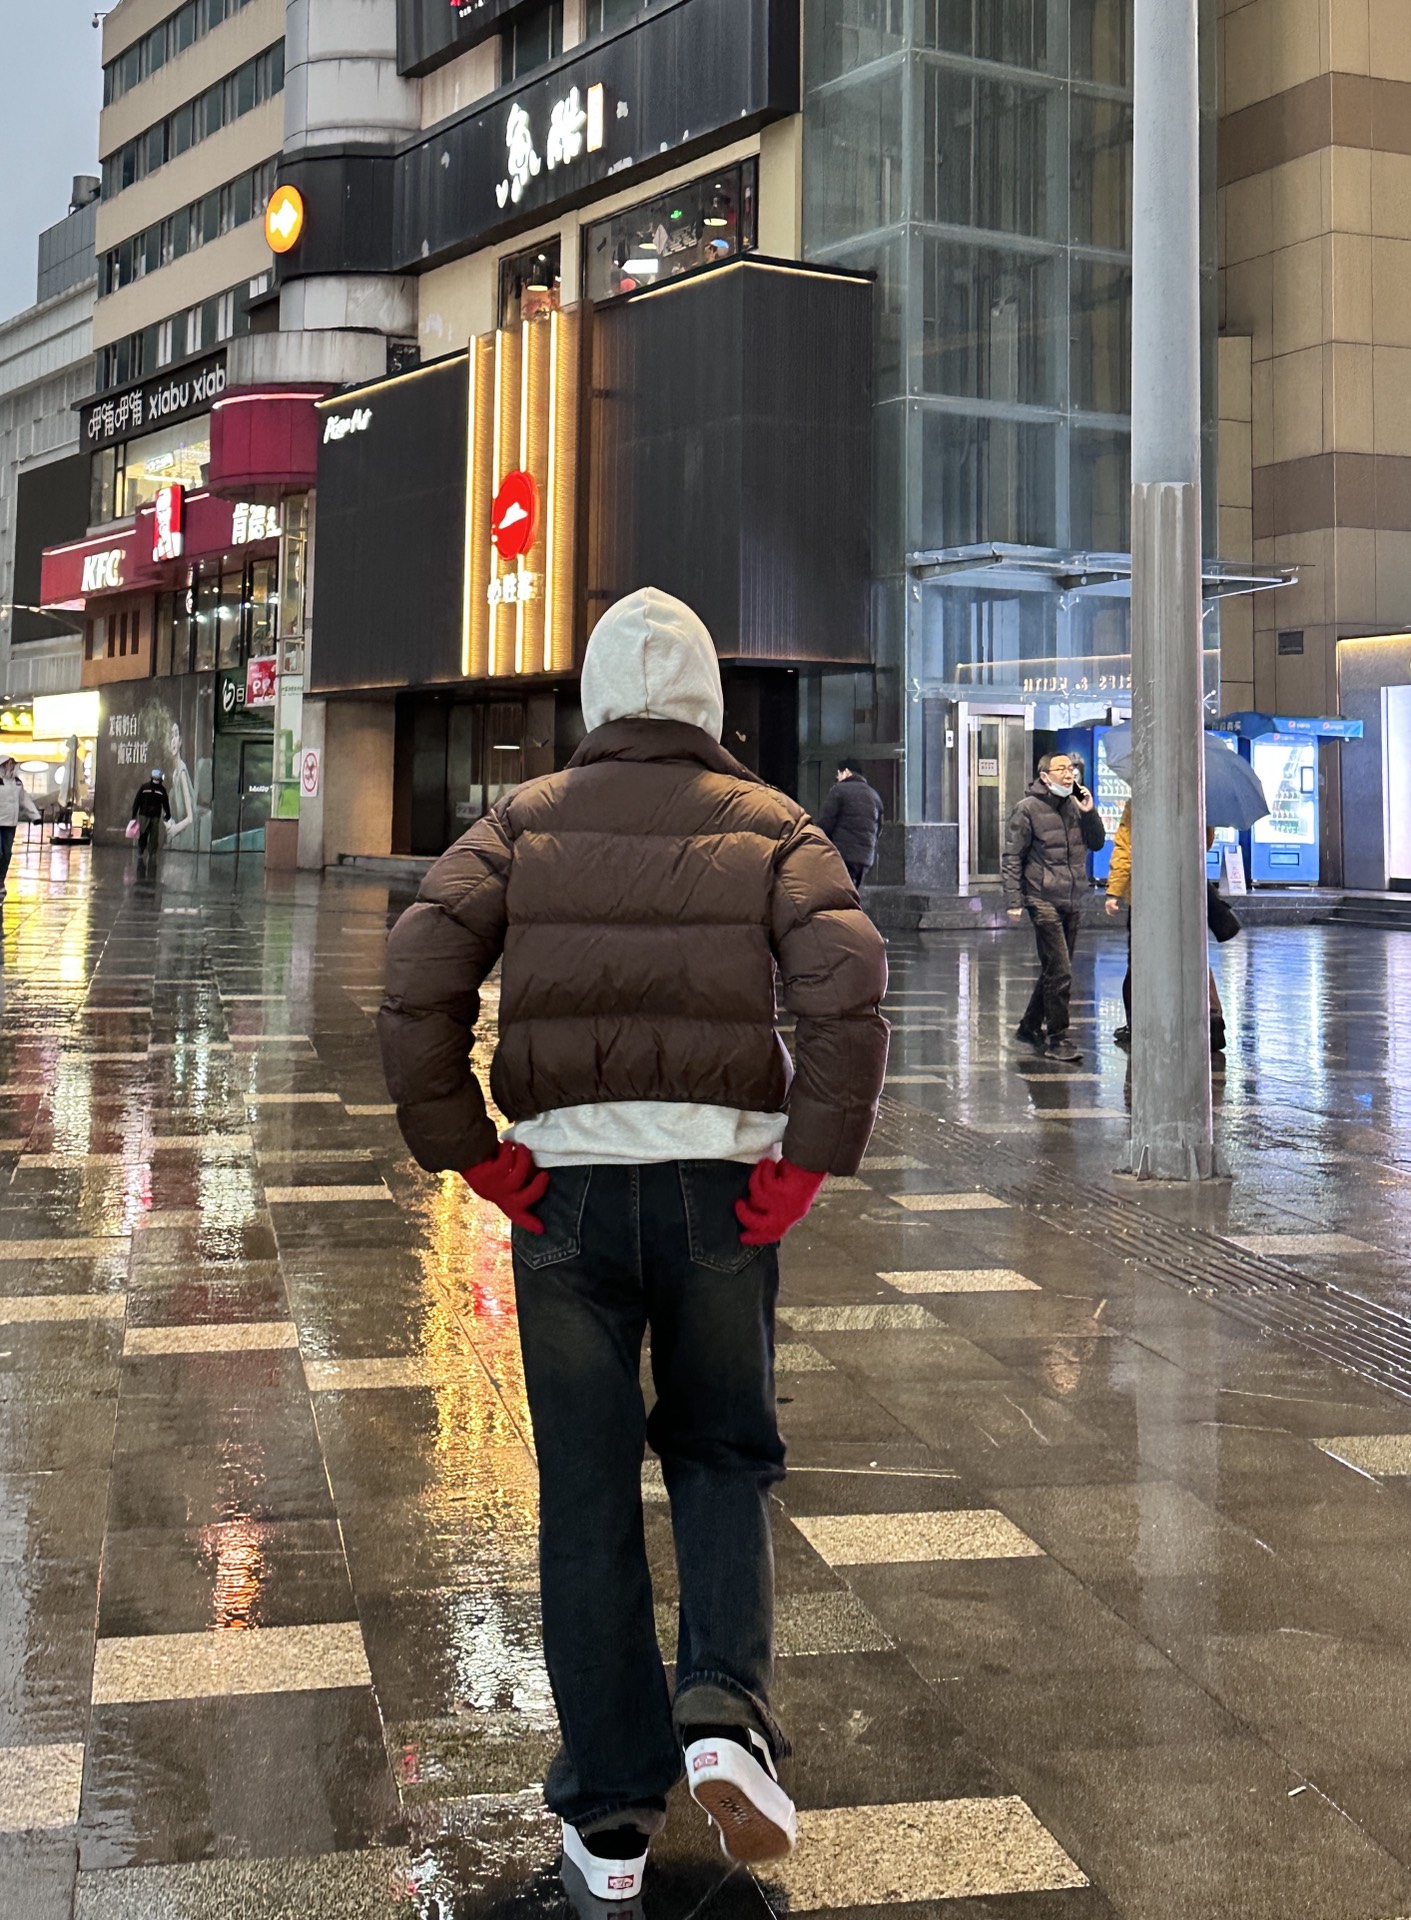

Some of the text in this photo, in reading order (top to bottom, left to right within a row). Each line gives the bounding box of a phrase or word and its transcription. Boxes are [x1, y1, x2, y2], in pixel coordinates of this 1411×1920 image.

[87, 389, 143, 441] 呷哺呷哺
[231, 502, 283, 545] 肯德基
[81, 549, 126, 592] KFC
